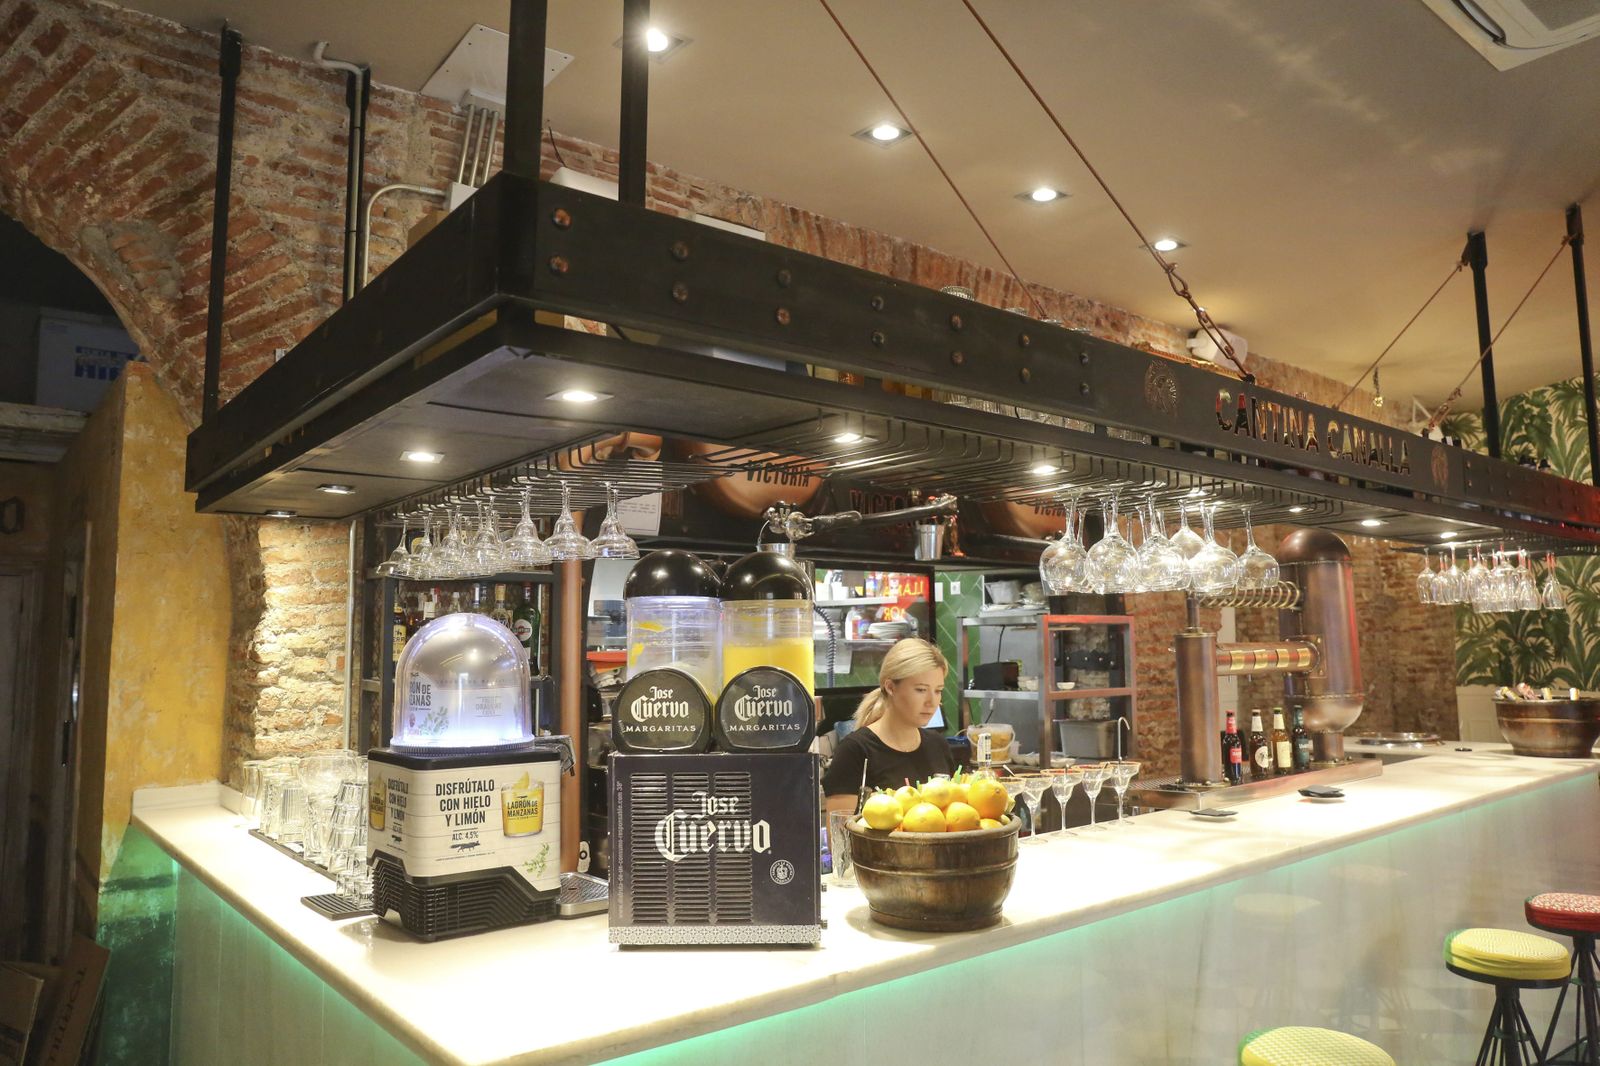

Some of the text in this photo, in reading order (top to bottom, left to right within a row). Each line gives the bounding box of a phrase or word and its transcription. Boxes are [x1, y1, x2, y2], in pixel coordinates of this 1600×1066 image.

[1215, 388, 1411, 476] CANTINA CANALLA
[421, 684, 432, 695] DE
[650, 685, 674, 702] Jose
[752, 684, 777, 701] Jose
[631, 695, 690, 723] Cuervo
[734, 694, 793, 722] Cuervo
[626, 725, 697, 733] MARGARITAS
[729, 723, 801, 732] MARGARITAS
[435, 778, 495, 796] DISFRÚTALO
[439, 795, 491, 812] CON HIELO
[507, 799, 531, 810] LADRÓN
[692, 791, 739, 818] Jose
[445, 808, 486, 827] Y LIMÓN
[507, 808, 538, 817] MANZANAS
[452, 831, 464, 841] ALC.
[654, 809, 771, 862] Cuervo
